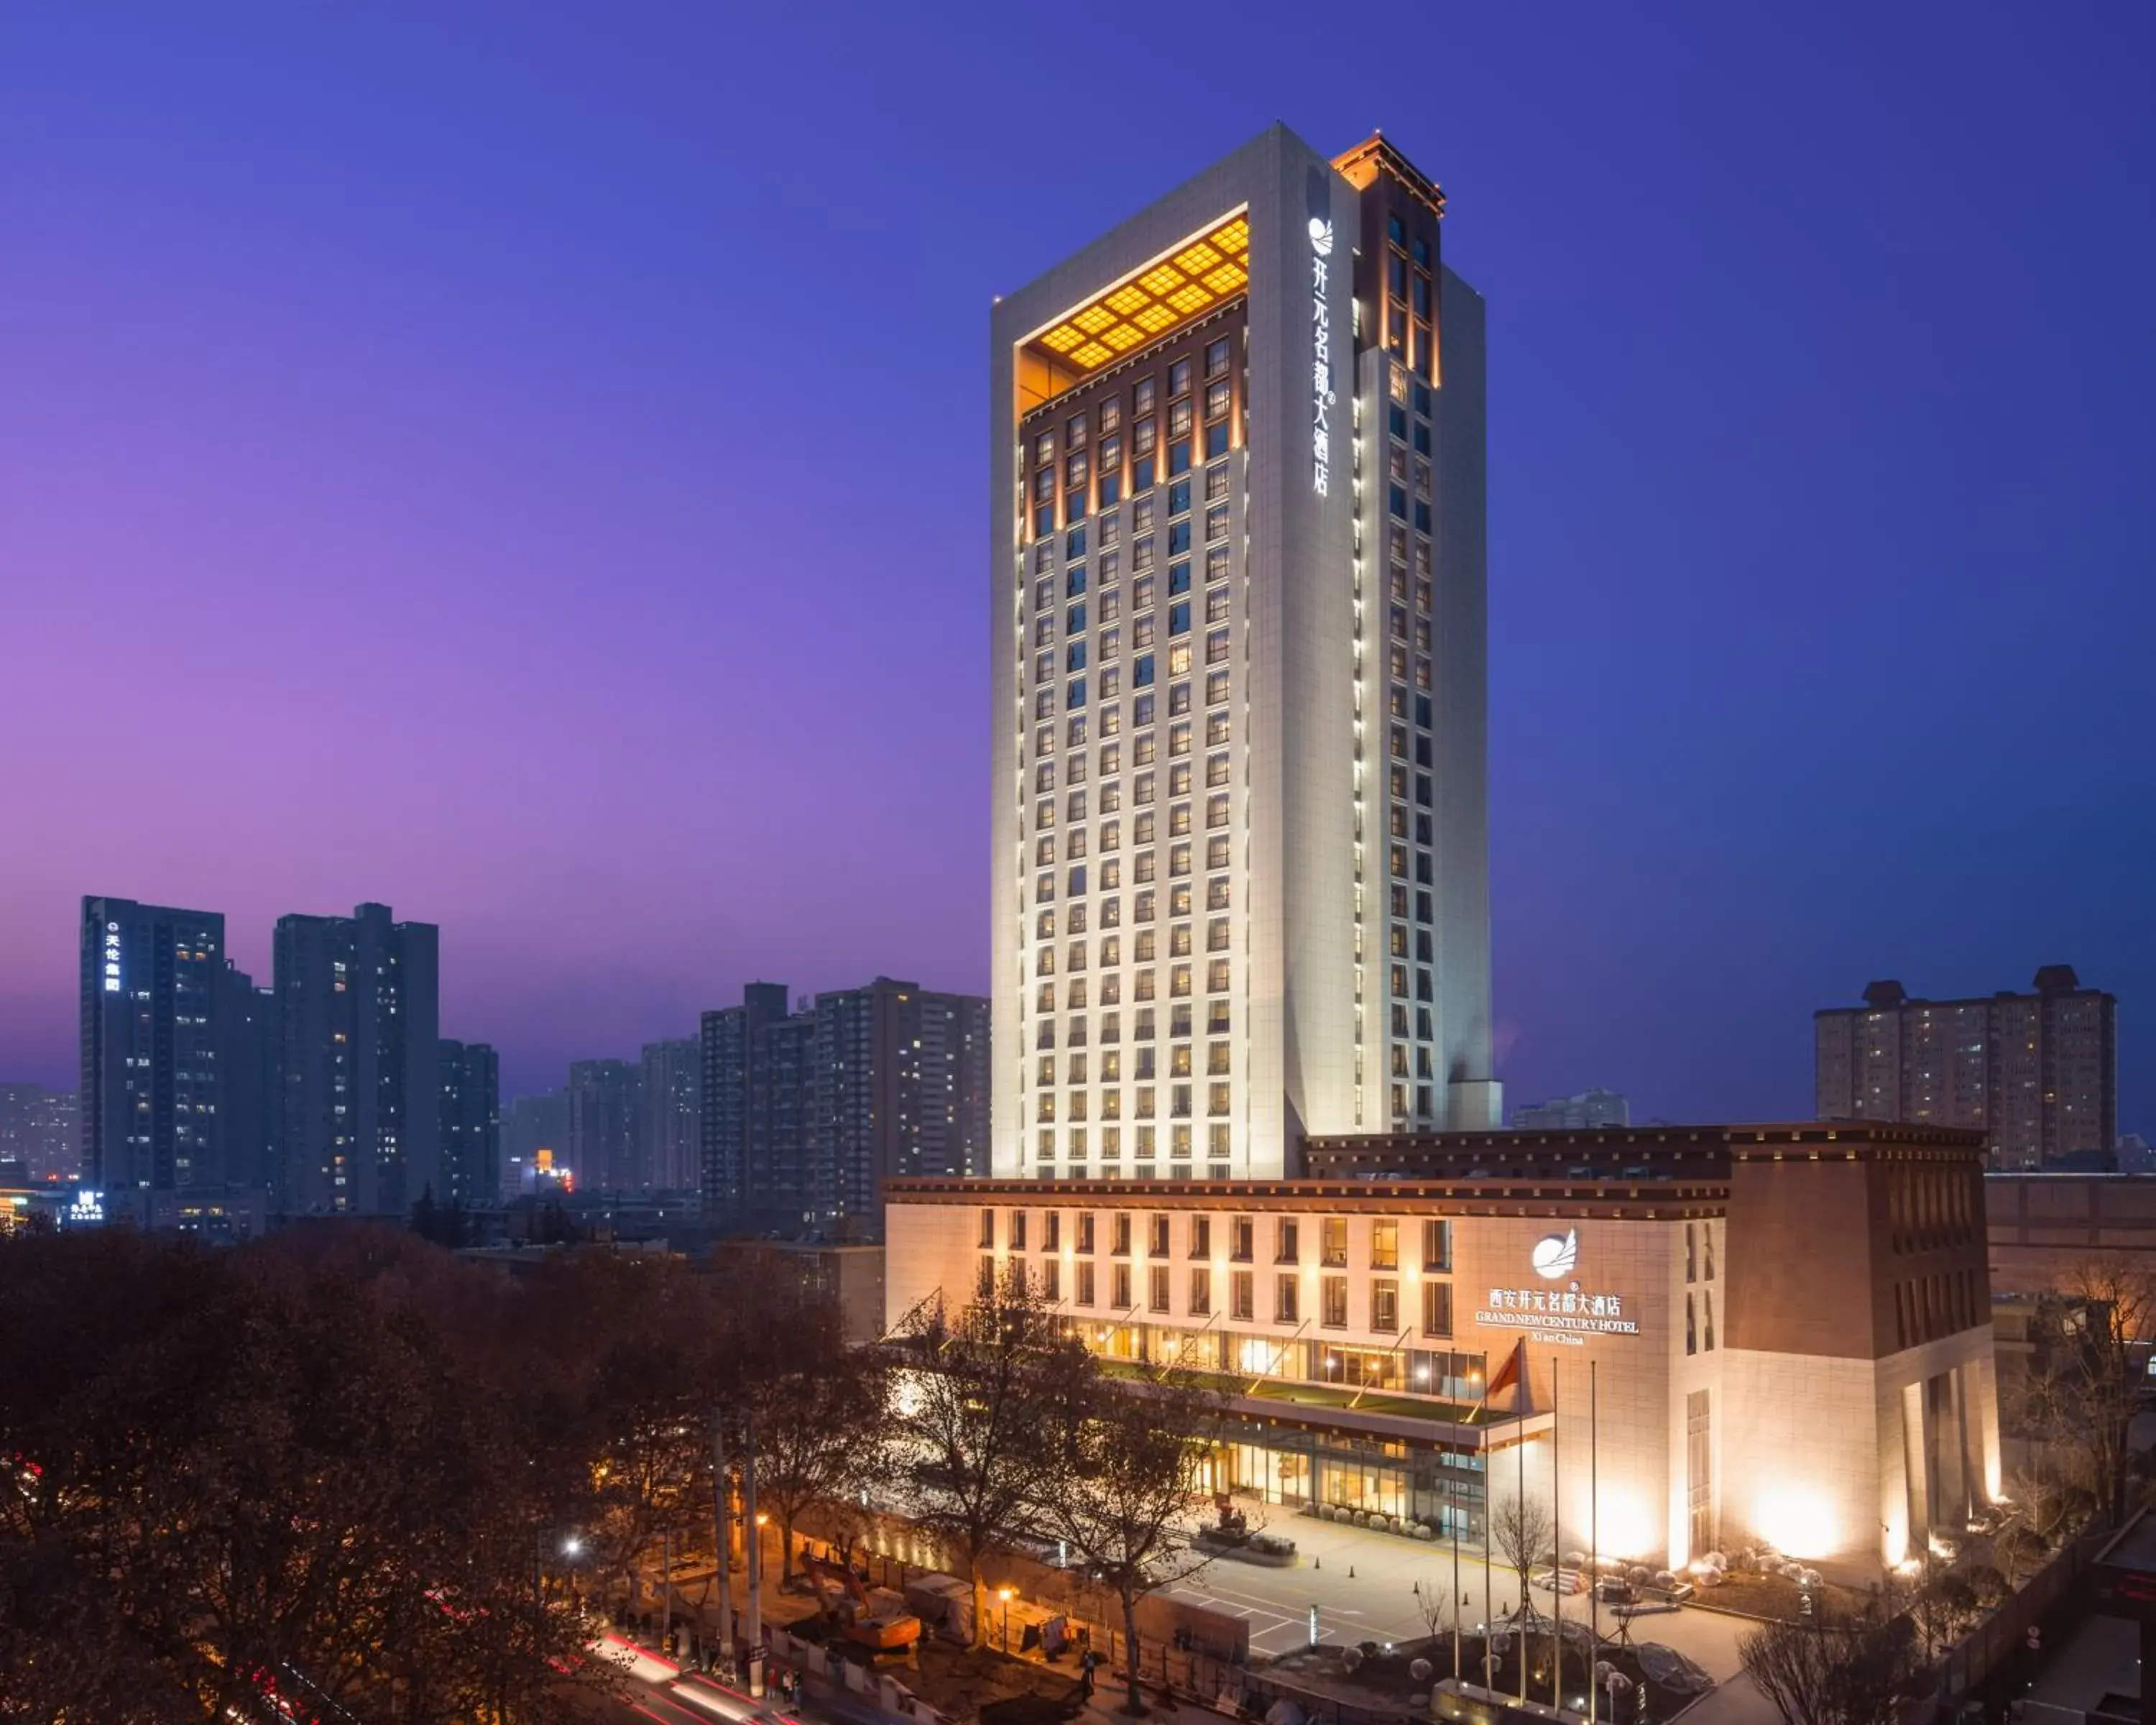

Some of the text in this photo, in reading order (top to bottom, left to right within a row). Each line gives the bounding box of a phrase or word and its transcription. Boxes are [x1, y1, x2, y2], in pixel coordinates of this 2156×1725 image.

[1312, 257, 1329, 497] 开元名都大酒店
[1490, 1289, 1621, 1316] 西安开元名都大酒店
[1475, 1310, 1639, 1333] GRAND NEW CENTURY HOTEL
[1555, 1333, 1584, 1345] China
